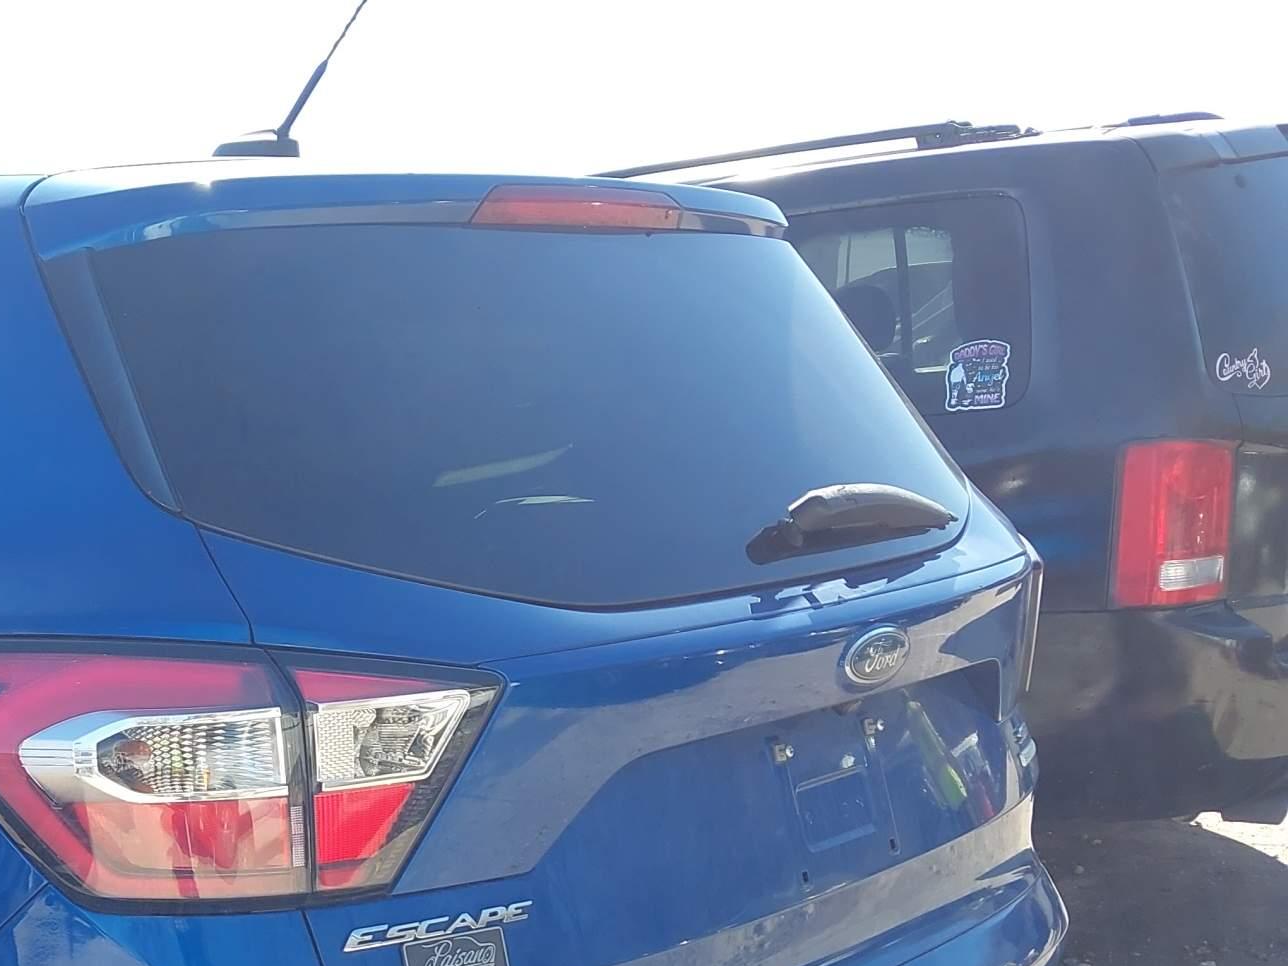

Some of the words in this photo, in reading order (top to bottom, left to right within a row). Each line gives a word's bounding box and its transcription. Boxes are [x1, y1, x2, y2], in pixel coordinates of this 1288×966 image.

[974, 392, 1001, 404] MINE
[865, 644, 901, 673] Ford
[343, 900, 534, 953] ESCAPE
